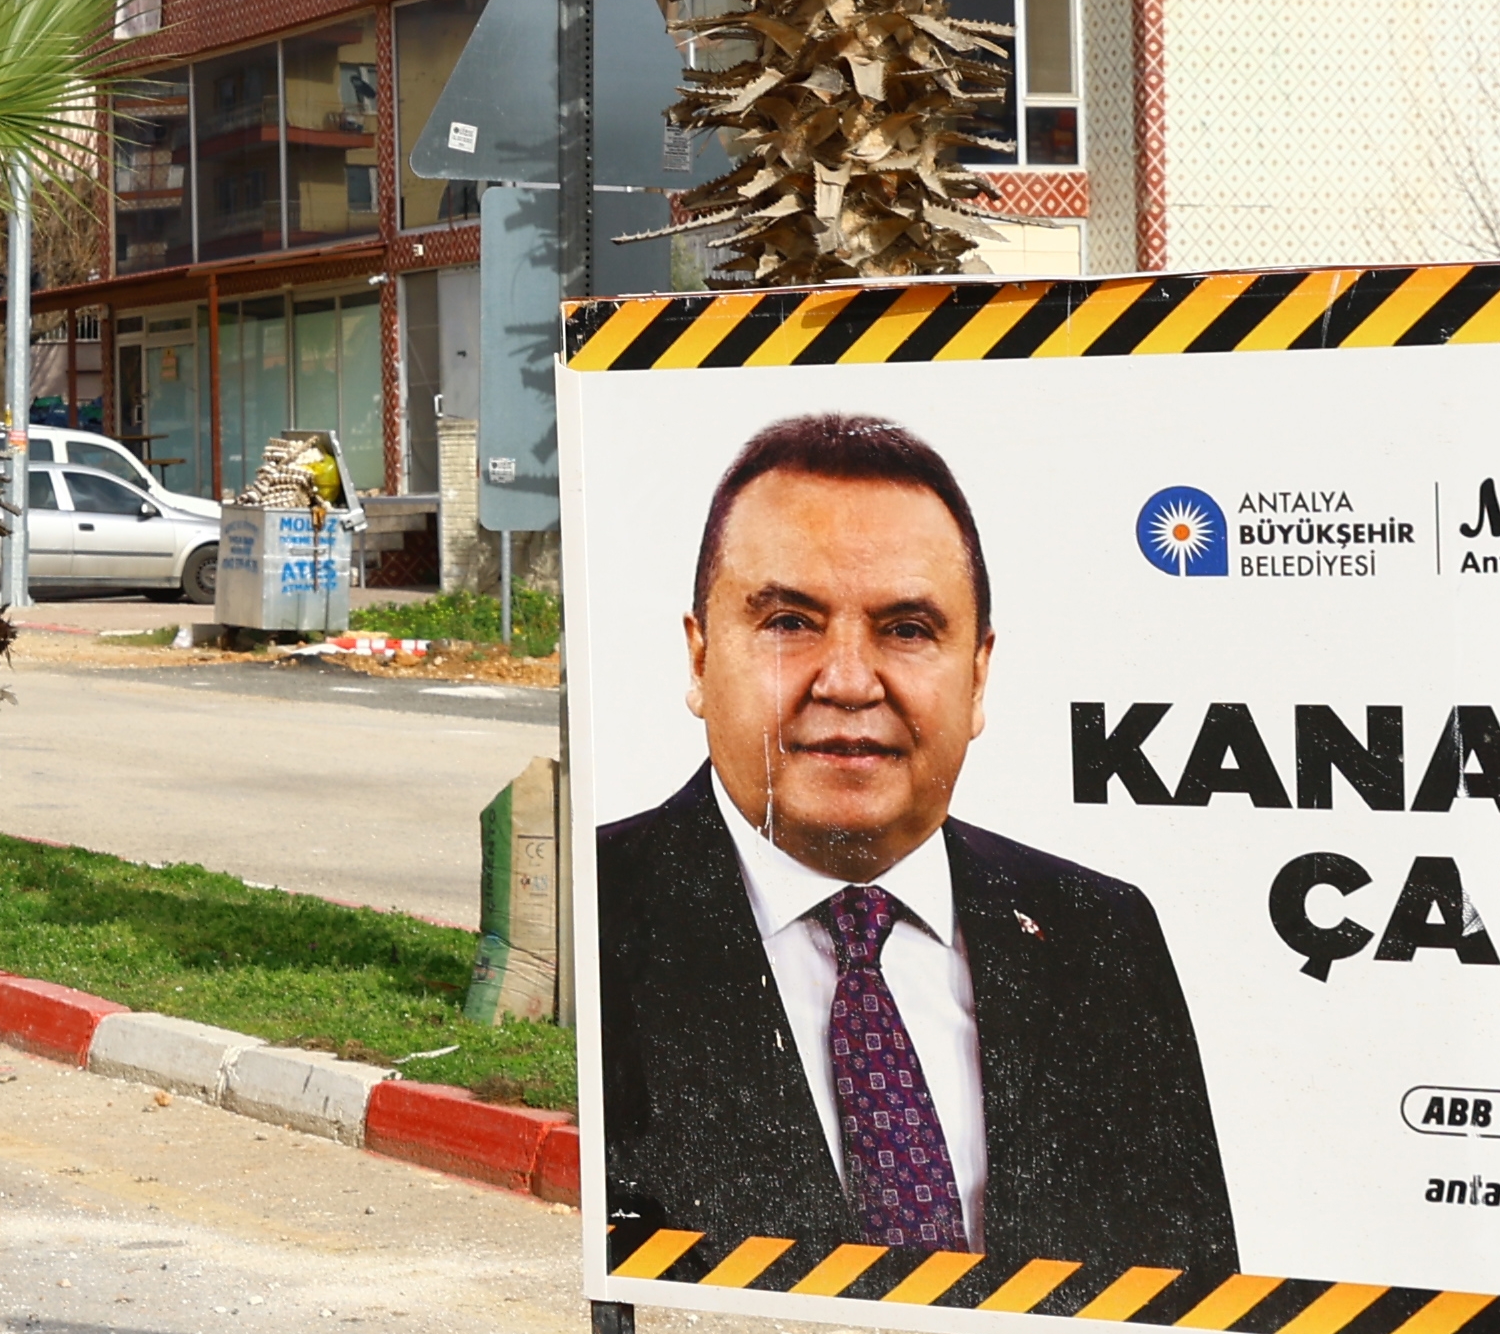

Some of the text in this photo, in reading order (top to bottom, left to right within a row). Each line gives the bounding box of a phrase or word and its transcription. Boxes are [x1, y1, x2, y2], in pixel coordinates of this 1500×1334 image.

[1238, 491, 1354, 513] ANTALYA
[1239, 517, 1415, 549] BÜYÜKŞEHİR
[1241, 551, 1376, 577] BELEDİYESİ
[1422, 1096, 1493, 1128] ABB
